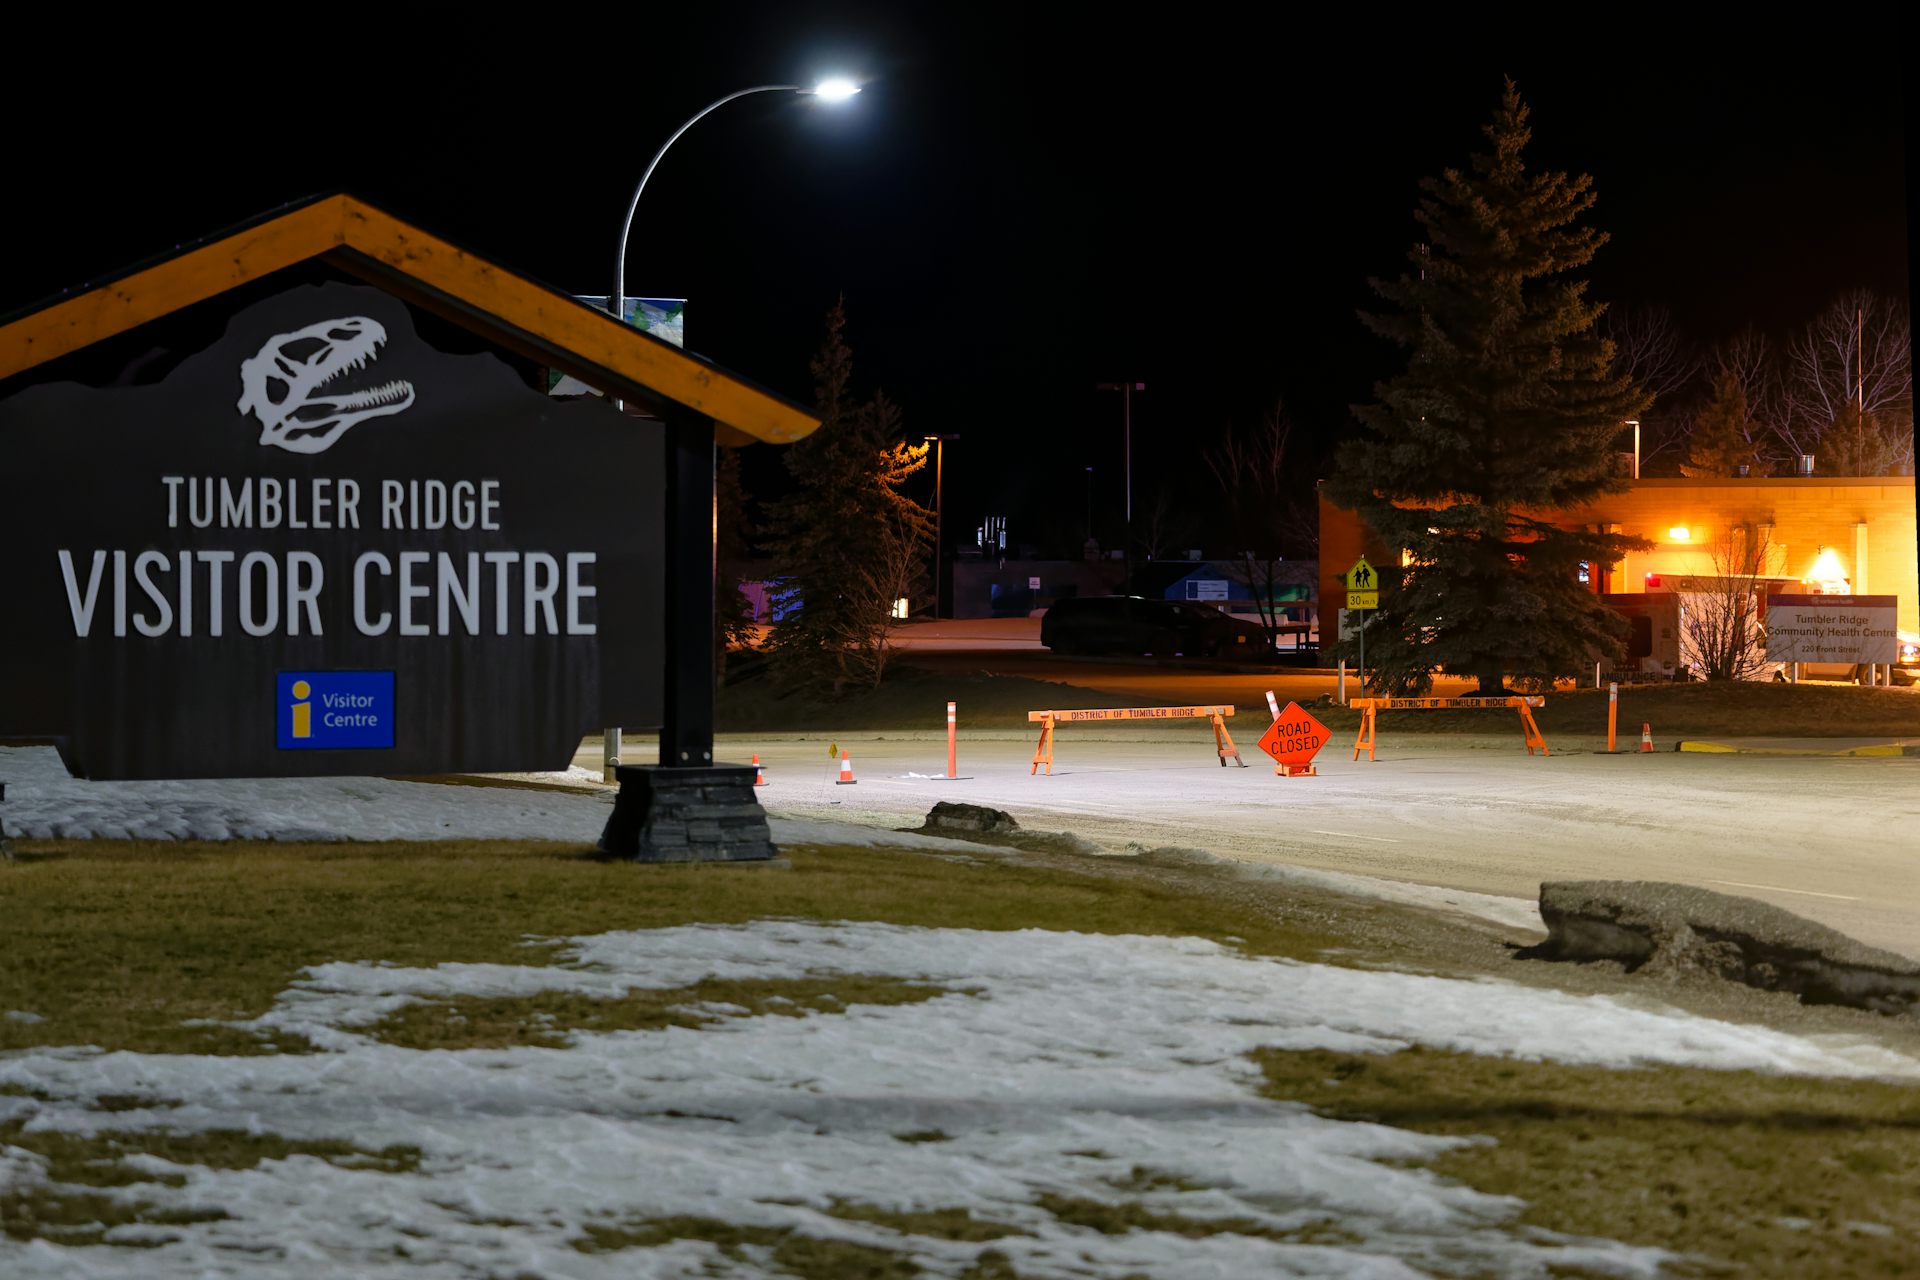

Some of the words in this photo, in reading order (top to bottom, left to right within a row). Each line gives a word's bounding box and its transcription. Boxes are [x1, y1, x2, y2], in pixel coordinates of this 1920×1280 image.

[162, 477, 360, 529] TUMBLER
[382, 479, 500, 530] RIDGE
[58, 549, 324, 637] VISITOR
[353, 551, 597, 636] CENTRE
[1350, 595, 1361, 605] 30
[1795, 614, 1836, 624] Tumbler
[1839, 615, 1869, 626] Ridge
[1767, 626, 1824, 638] Community
[1828, 627, 1860, 637] Health
[1863, 628, 1897, 638] Centre
[1801, 645, 1814, 653] 220
[1816, 645, 1836, 653] Front
[322, 693, 374, 708] Visitor
[1391, 699, 1426, 708] DISTRICT
[1430, 699, 1440, 707] OF
[1445, 699, 1480, 707] TUMBLER
[1485, 699, 1507, 707] RIDGE
[324, 712, 378, 727] Centre
[1071, 711, 1108, 720] DISTRICT
[1113, 710, 1123, 718] OF
[1128, 709, 1167, 718] TUMBLER
[1172, 708, 1195, 717] RIDGE
[1277, 720, 1311, 738] ROAD
[1271, 736, 1319, 755] CLOSED
